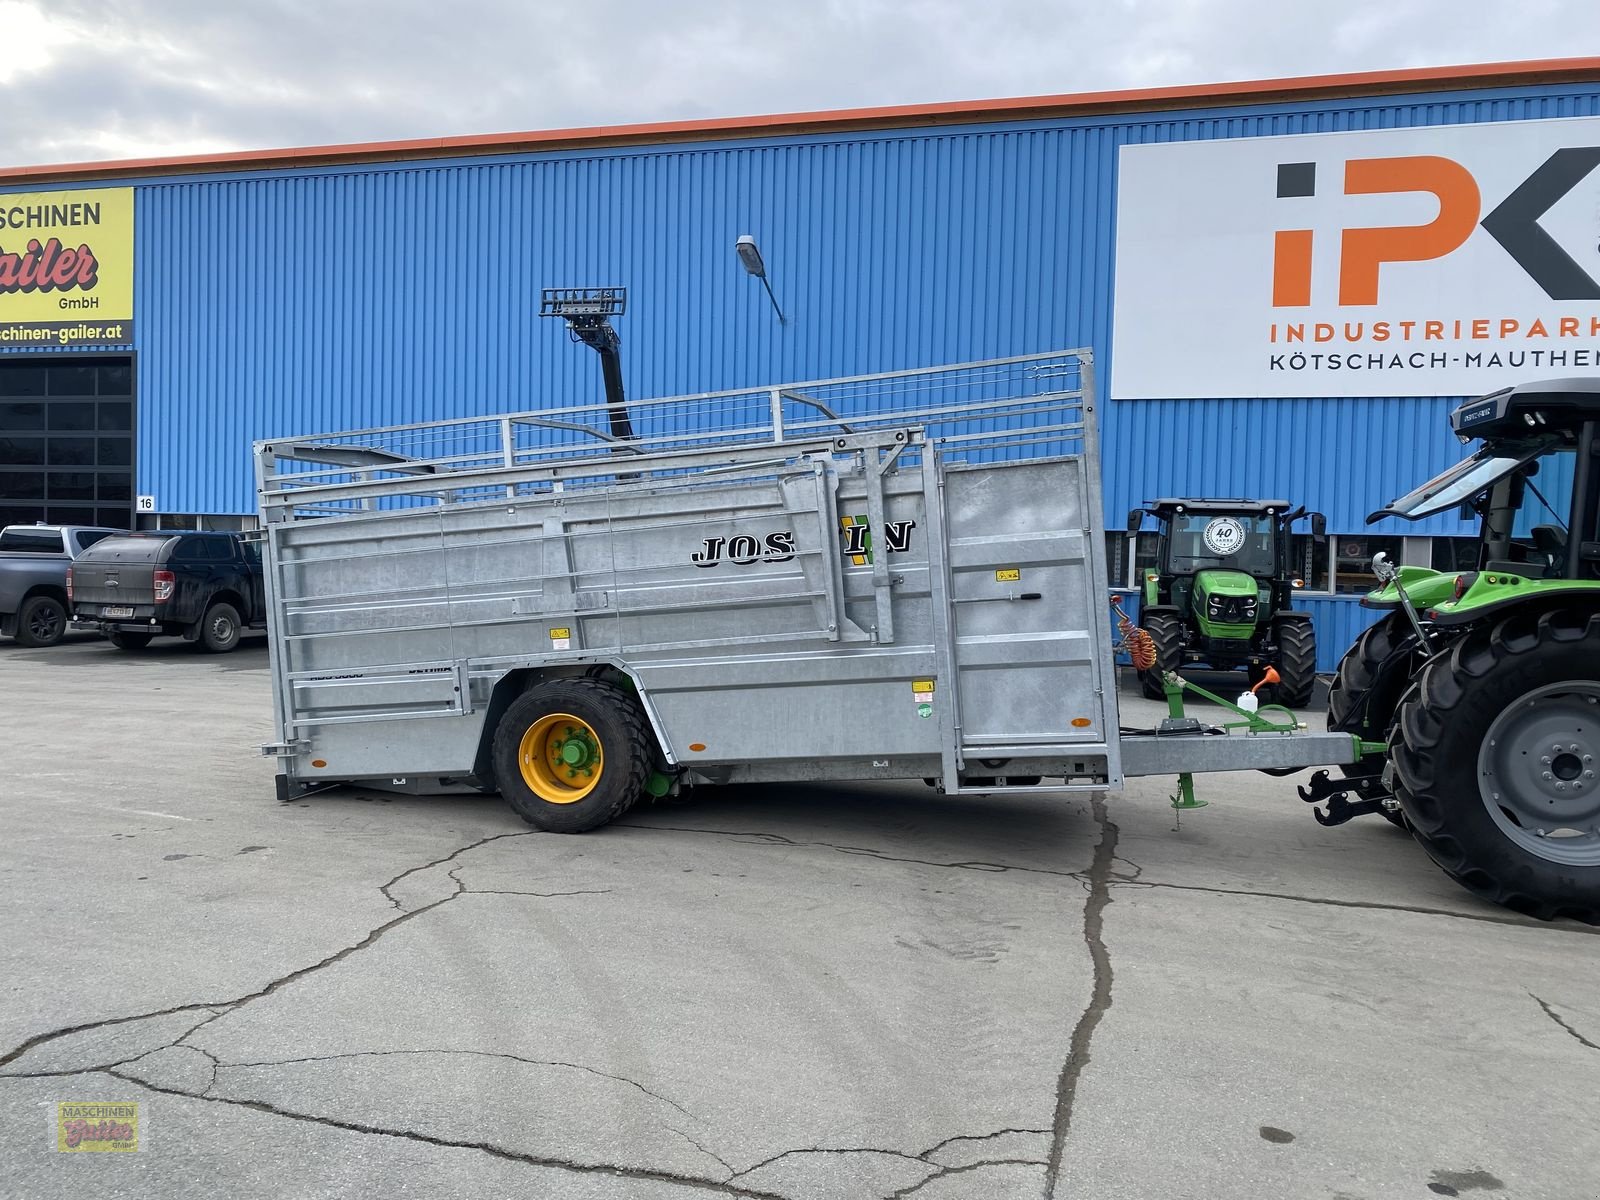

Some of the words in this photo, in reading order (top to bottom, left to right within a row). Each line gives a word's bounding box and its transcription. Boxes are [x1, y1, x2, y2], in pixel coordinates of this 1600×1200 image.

[0, 237, 99, 295] ailer
[59, 297, 99, 309] GmbH
[0, 324, 122, 344] chinen-gailer.at
[1270, 349, 1600, 371] KÖTSCHACH-MAUTHE
[140, 498, 152, 509] 16
[1216, 528, 1233, 538] 40
[690, 519, 916, 568] JOSIN
